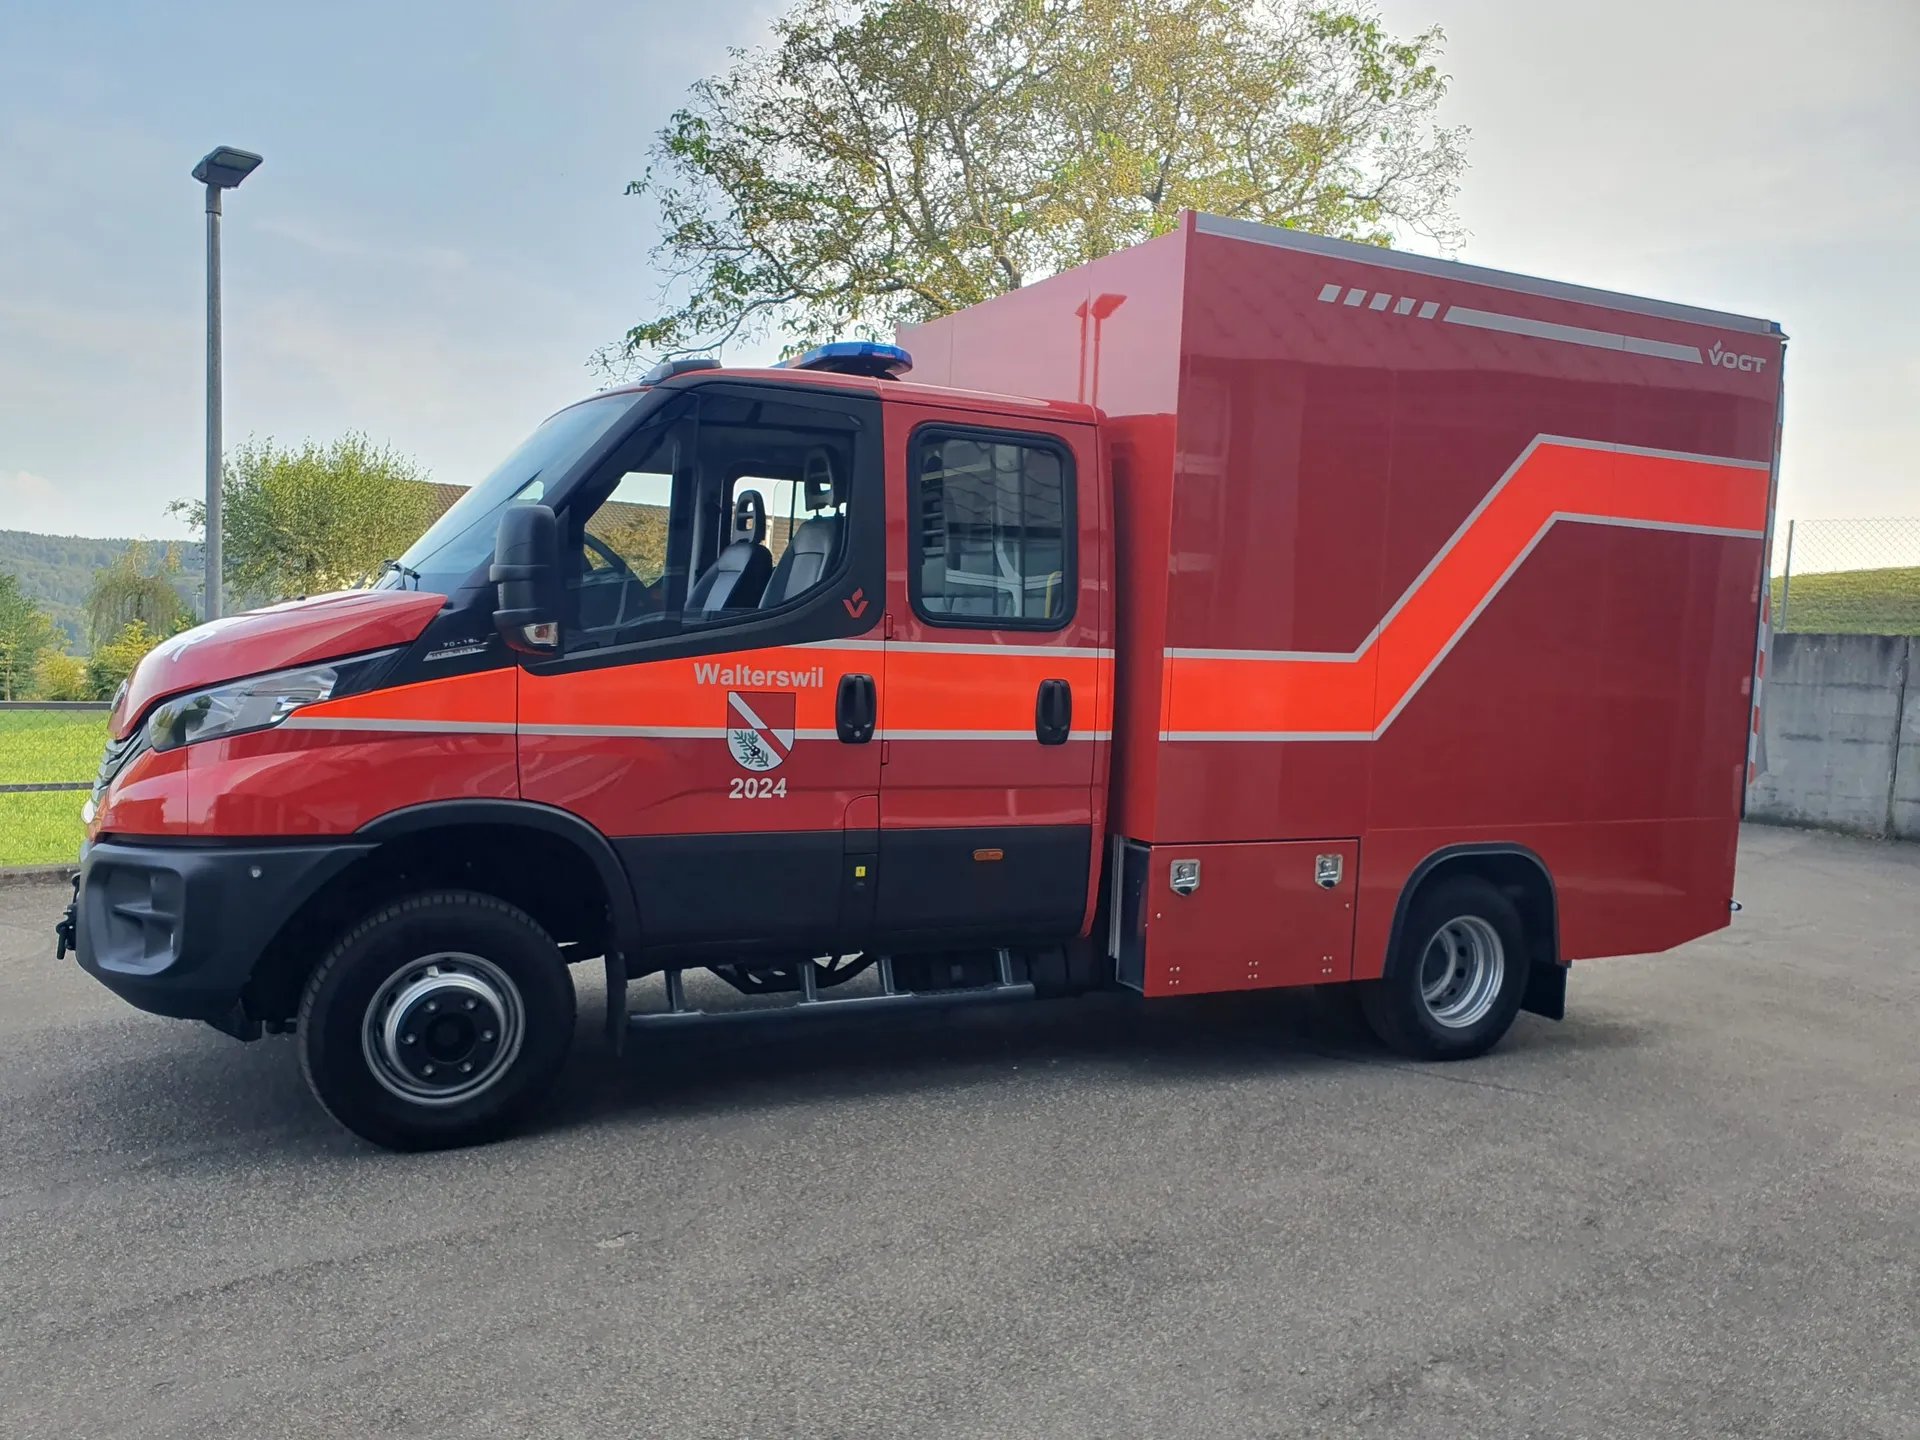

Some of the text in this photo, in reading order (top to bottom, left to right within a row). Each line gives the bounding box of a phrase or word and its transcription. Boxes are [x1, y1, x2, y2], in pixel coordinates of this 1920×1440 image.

[1708, 344, 1767, 373] VOGT
[693, 663, 824, 688] Walterswil
[728, 777, 787, 799] 2024
